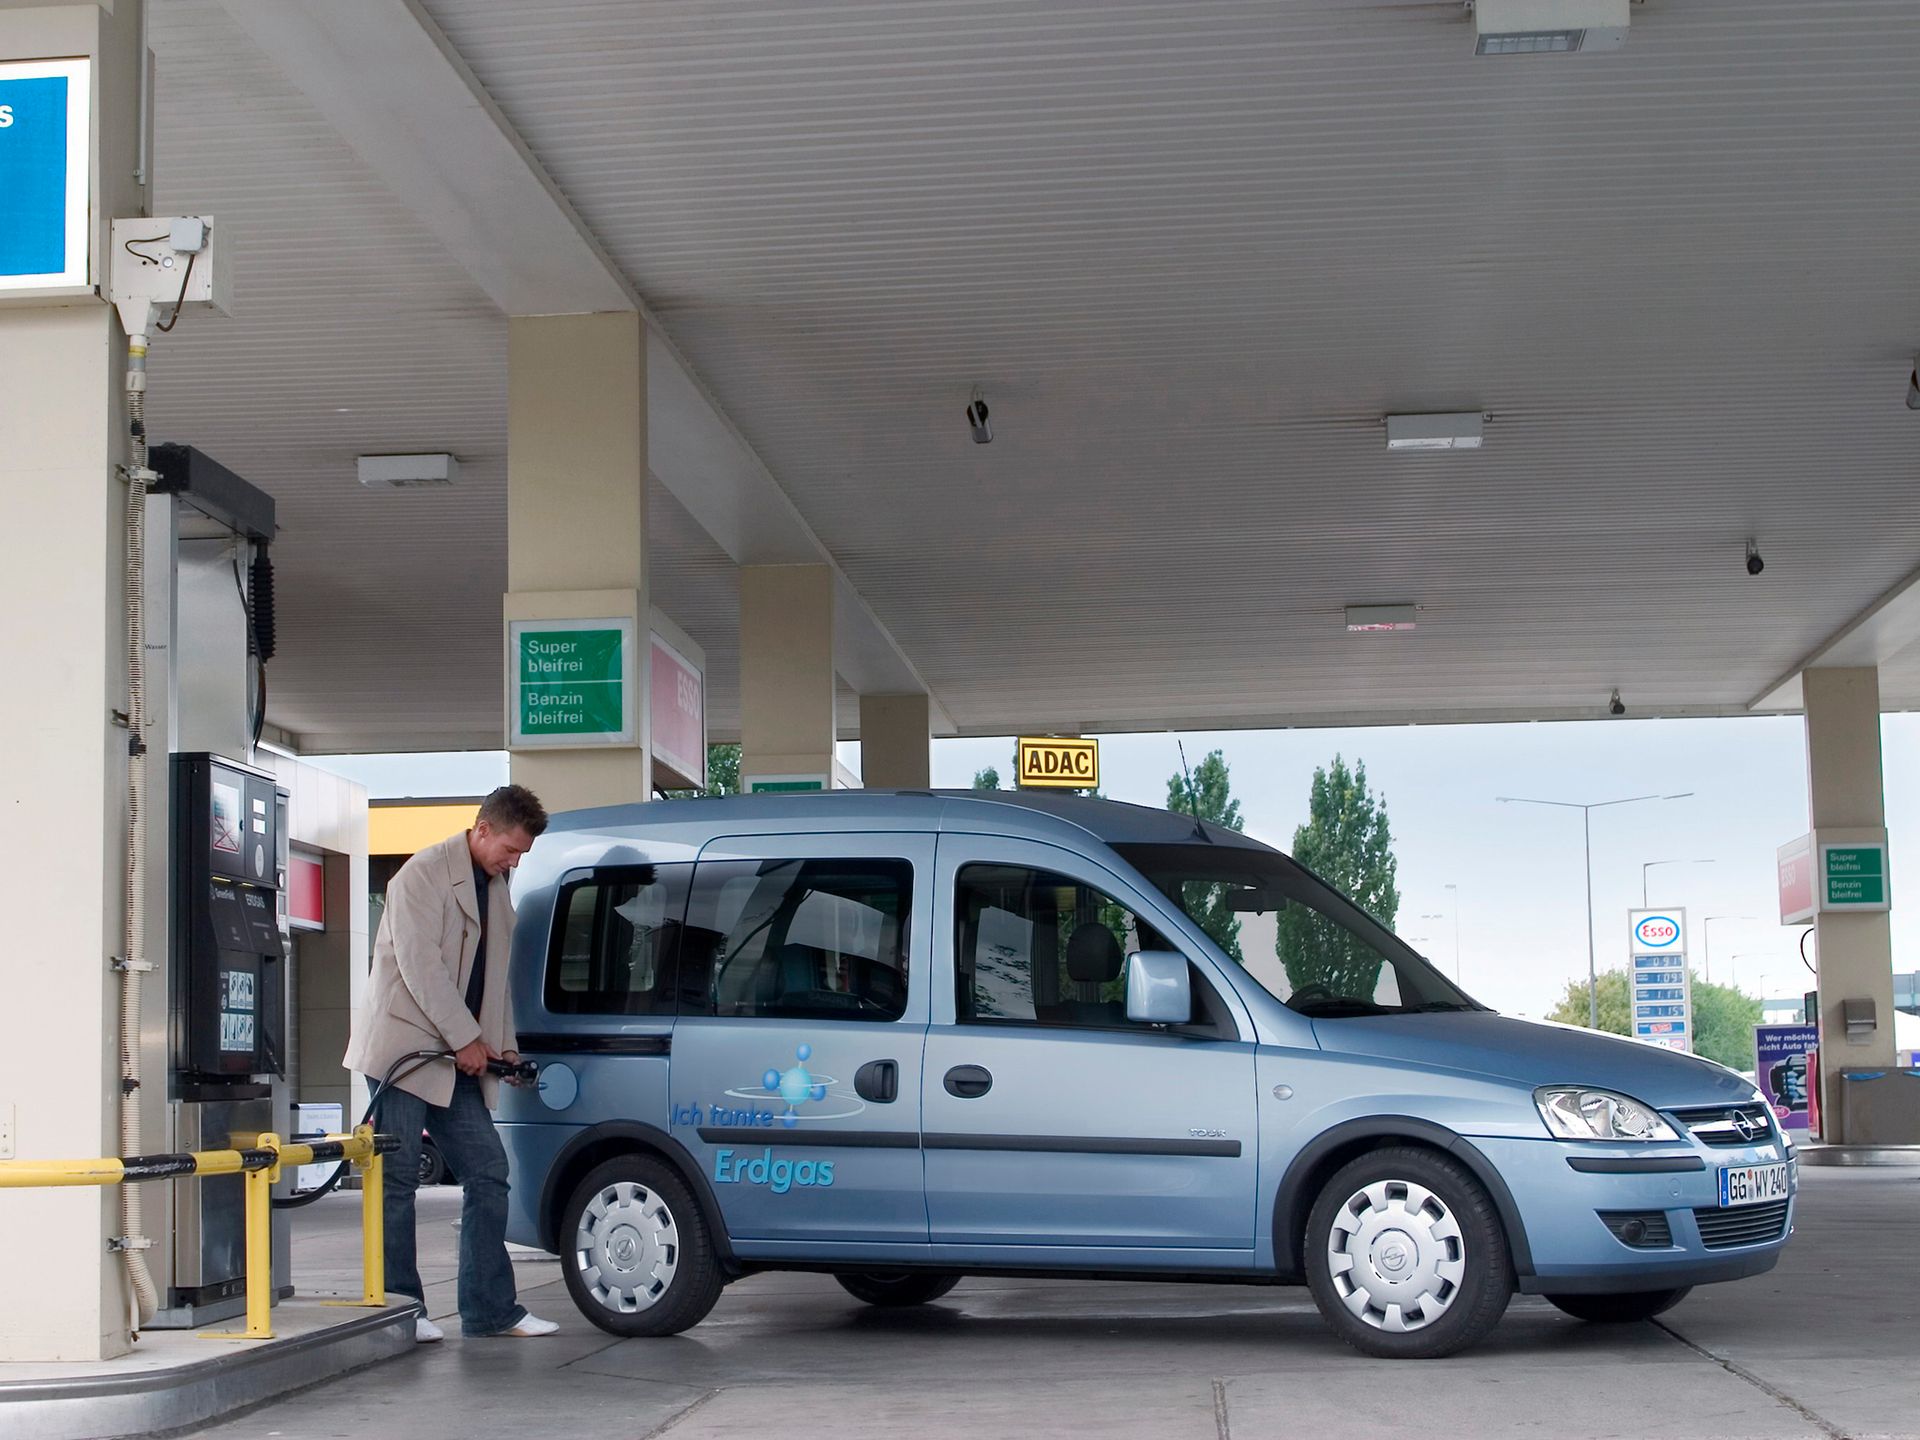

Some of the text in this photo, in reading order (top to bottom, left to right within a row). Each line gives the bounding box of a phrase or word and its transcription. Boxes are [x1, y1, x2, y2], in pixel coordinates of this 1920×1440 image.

[528, 640, 577, 655] Super
[528, 658, 583, 673] bleifrei
[528, 692, 583, 706] Benzin
[528, 710, 583, 725] bleifrei
[1028, 750, 1089, 775] ADAC
[1830, 853, 1857, 862] Super
[1830, 863, 1861, 872] bleifrei
[1831, 880, 1861, 889] Benzin
[1832, 891, 1862, 899] bleifrei
[1765, 1033, 1816, 1042] Wer möchte
[1759, 1043, 1780, 1051] nicht
[1782, 1042, 1802, 1050] Auto
[672, 1102, 774, 1127] Ich tanke
[1189, 1128, 1226, 1137] TOUR
[714, 1148, 834, 1194] Erdgas
[1729, 1172, 1747, 1201] GG
[1754, 1169, 1768, 1198] WY
[1770, 1166, 1787, 1196] 240
